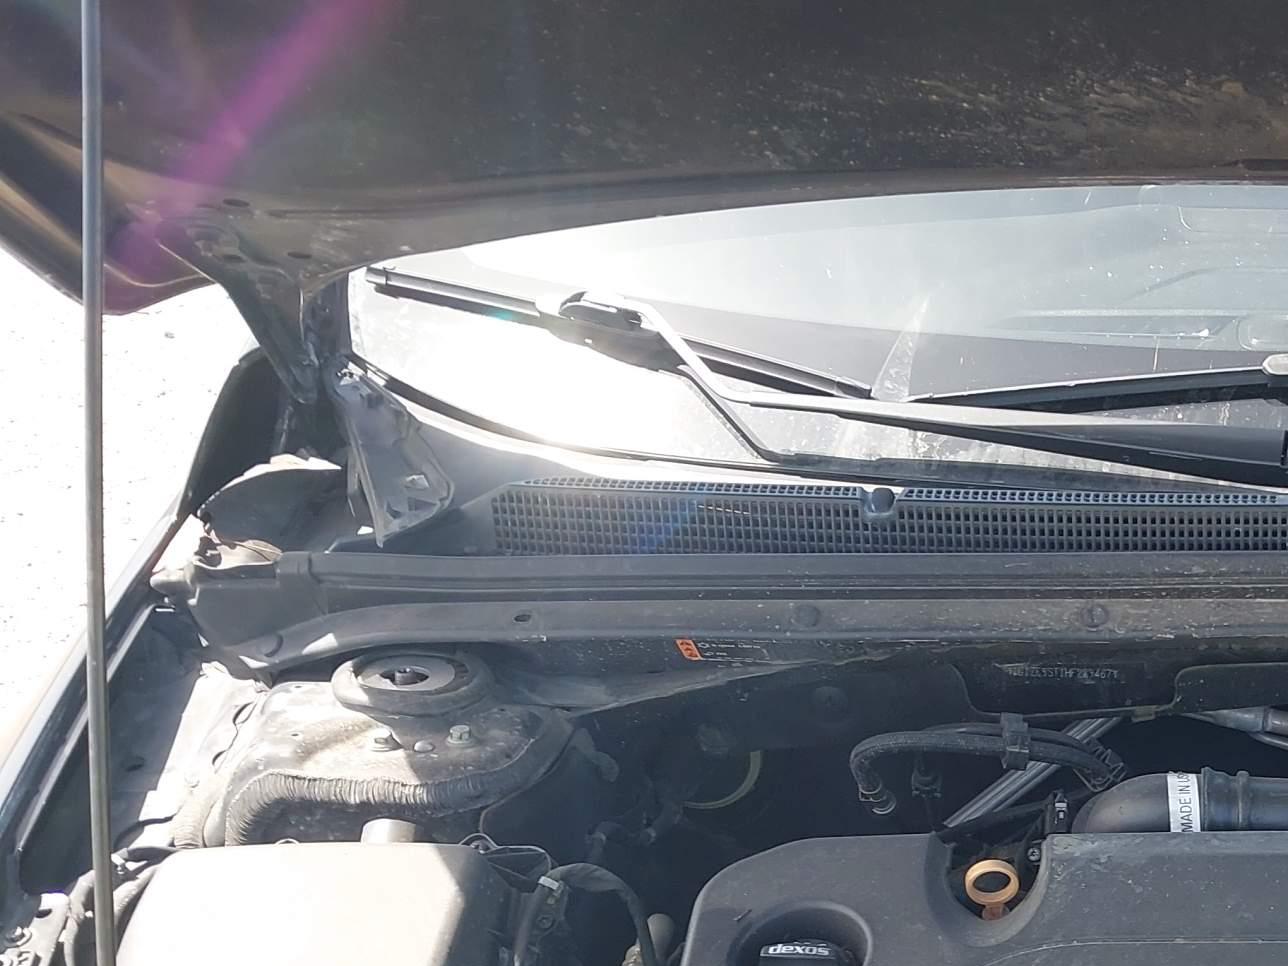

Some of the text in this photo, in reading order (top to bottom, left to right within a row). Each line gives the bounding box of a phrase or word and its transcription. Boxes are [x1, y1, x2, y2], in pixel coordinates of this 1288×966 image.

[1177, 785, 1191, 794] IN
[1180, 797, 1193, 832] MADE
[768, 943, 831, 956] dexos
